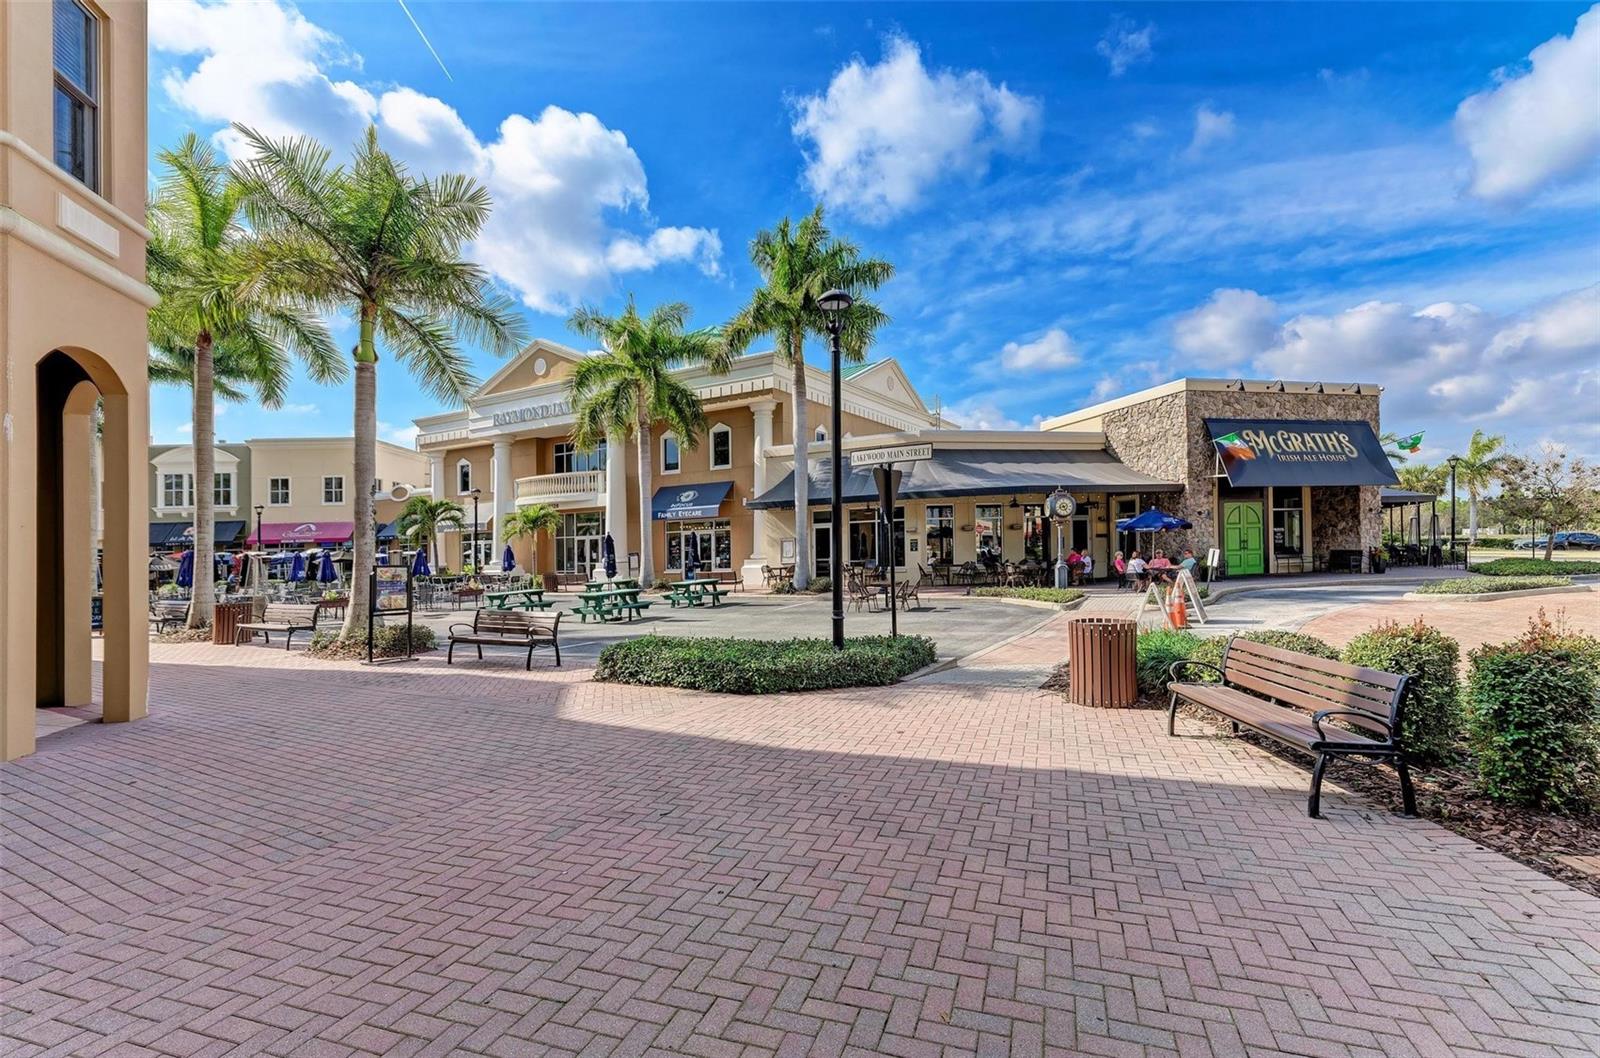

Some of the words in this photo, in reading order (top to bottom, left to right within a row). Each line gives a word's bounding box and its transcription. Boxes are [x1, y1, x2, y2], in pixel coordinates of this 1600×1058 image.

[493, 405, 550, 426] RAYMOND
[853, 452, 886, 463] LAKEWOOD
[886, 450, 904, 459] MAIN
[905, 448, 930, 458] STREET
[1277, 454, 1301, 462] IRISH
[1302, 454, 1318, 462] ALE
[1319, 454, 1347, 462] HOUSE
